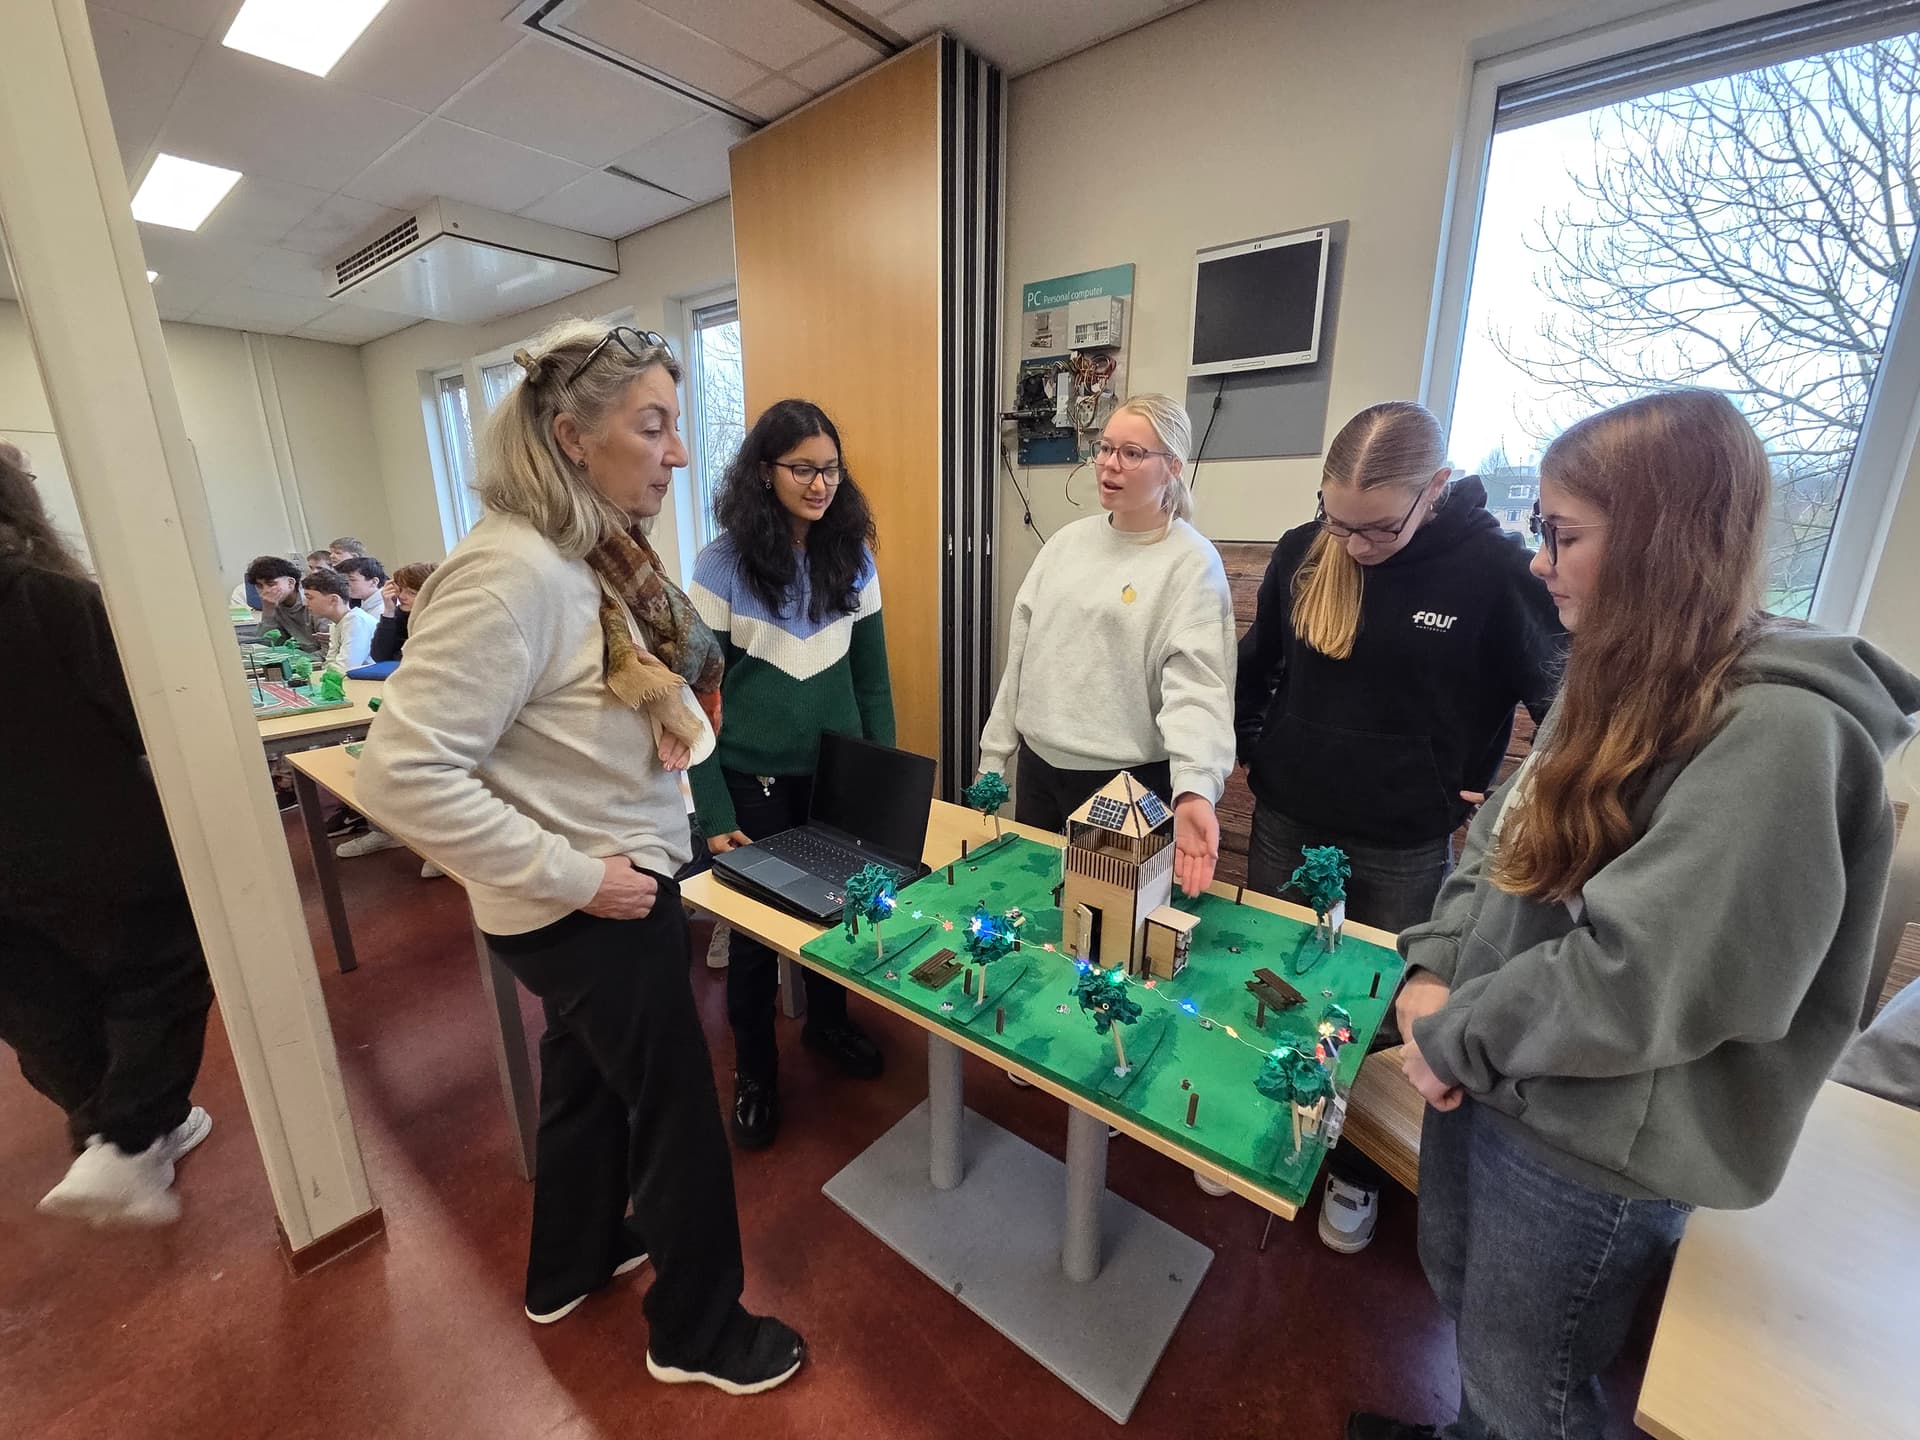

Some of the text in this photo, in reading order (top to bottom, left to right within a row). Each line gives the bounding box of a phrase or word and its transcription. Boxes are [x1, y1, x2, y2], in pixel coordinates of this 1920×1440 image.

[1027, 287, 1103, 308] PC Personal computer
